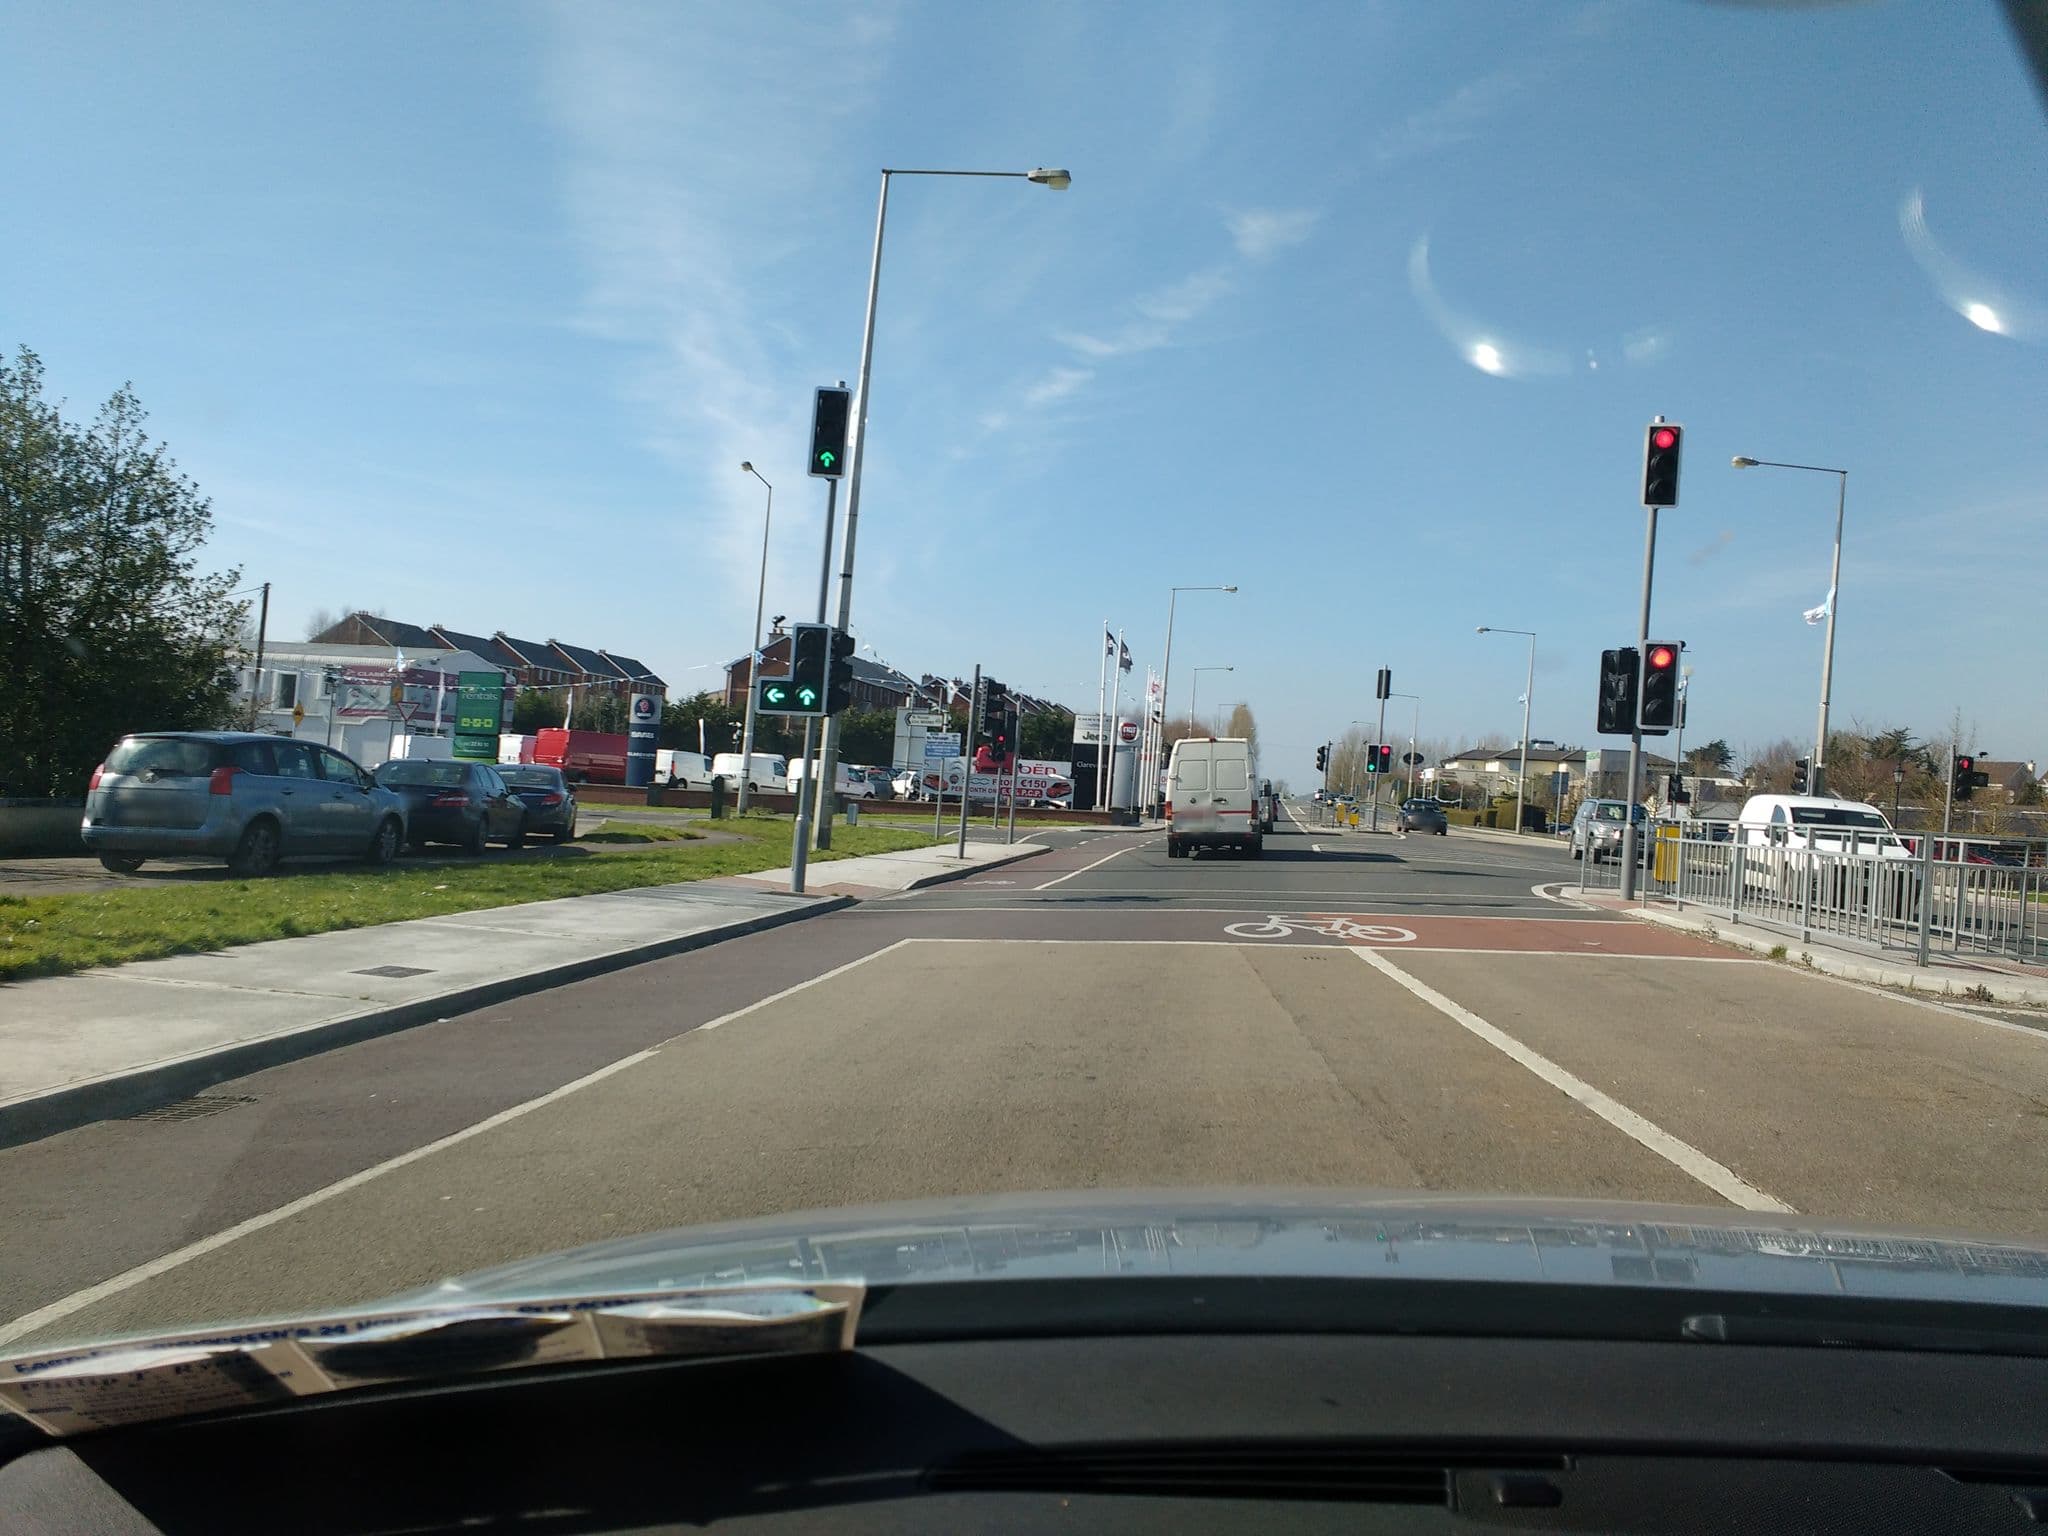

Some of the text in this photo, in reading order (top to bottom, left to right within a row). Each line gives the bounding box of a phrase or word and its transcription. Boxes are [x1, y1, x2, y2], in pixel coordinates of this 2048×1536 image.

[462, 692, 499, 700] rentals
[1082, 731, 1108, 741] Jeep
[1020, 780, 1048, 788] €150
[1021, 789, 1042, 798] P.C.P.
